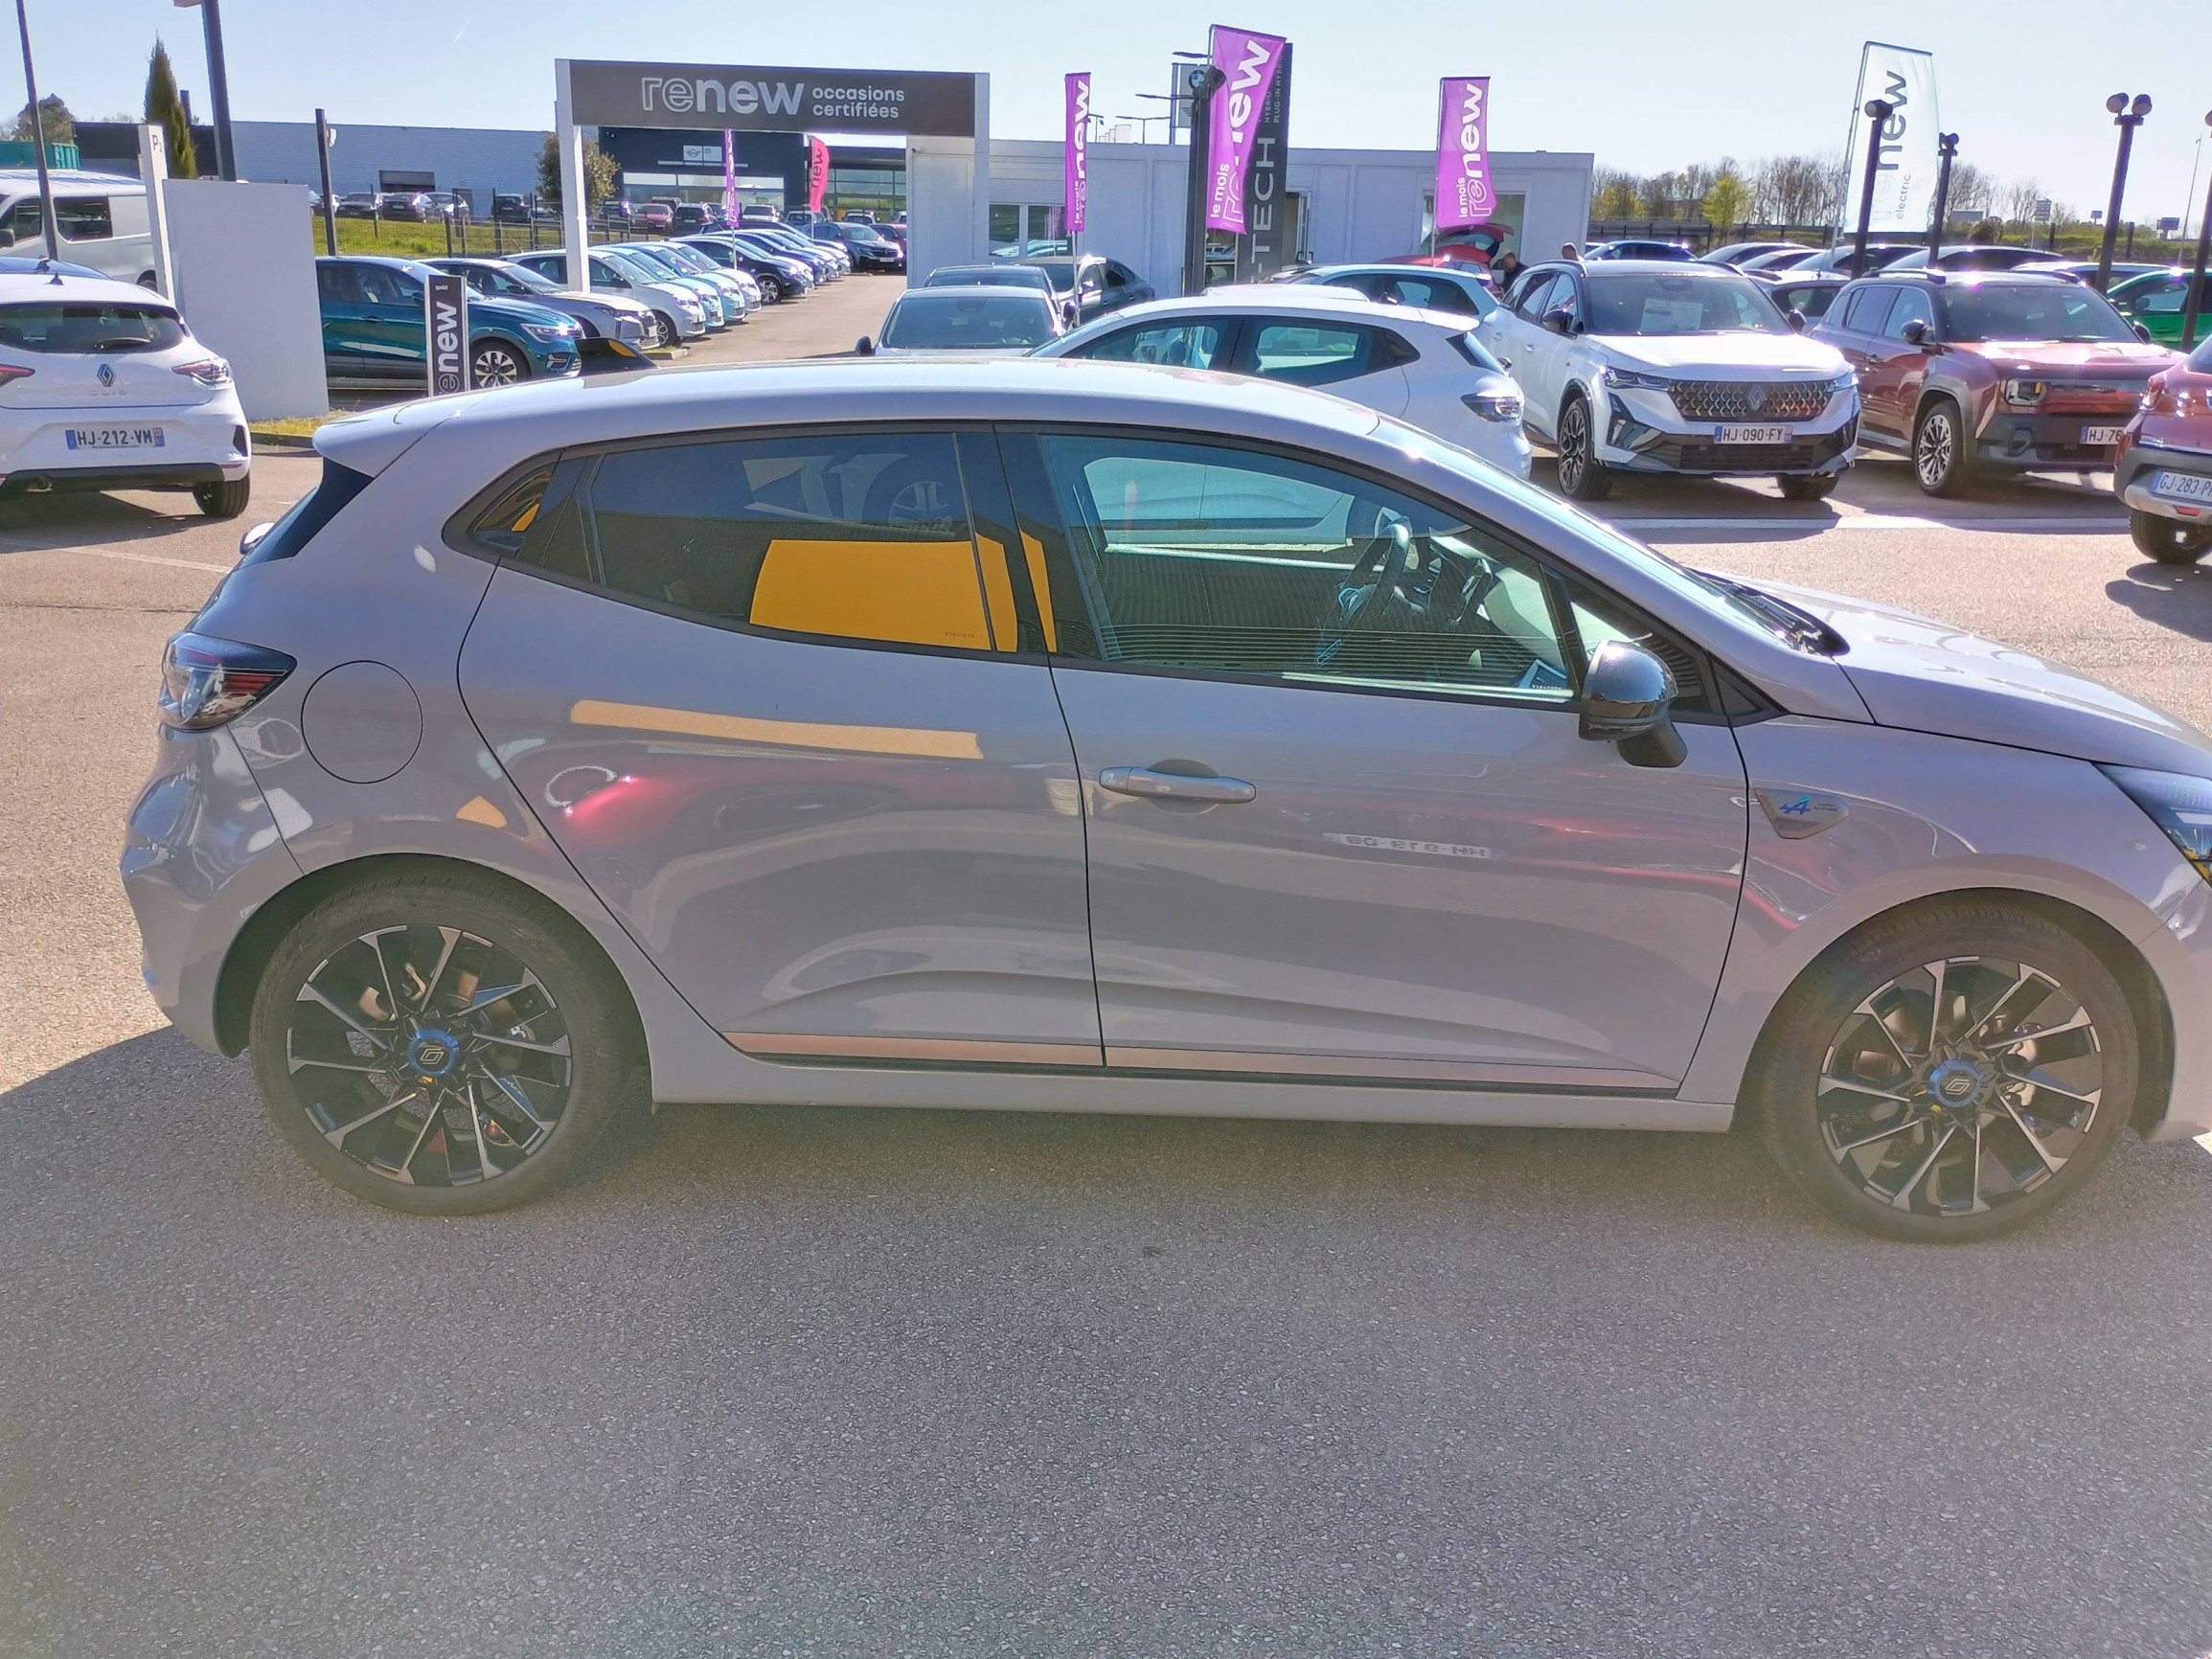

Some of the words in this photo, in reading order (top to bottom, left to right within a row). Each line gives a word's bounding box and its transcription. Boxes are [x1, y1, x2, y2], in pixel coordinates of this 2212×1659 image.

[641, 77, 805, 116] renew
[811, 85, 905, 102] occasions
[811, 102, 900, 119] certifiées
[1460, 82, 1492, 217] renew
[1215, 163, 1230, 202] mois
[1456, 176, 1469, 208] mois
[1895, 173, 1912, 220] electric
[1210, 204, 1221, 218] le
[1458, 208, 1469, 218] le
[436, 301, 460, 395] enew
[77, 429, 153, 445] HJ-212-VM
[1722, 427, 1784, 442] HJ-090-FY
[2088, 429, 2124, 442] HJ-76
